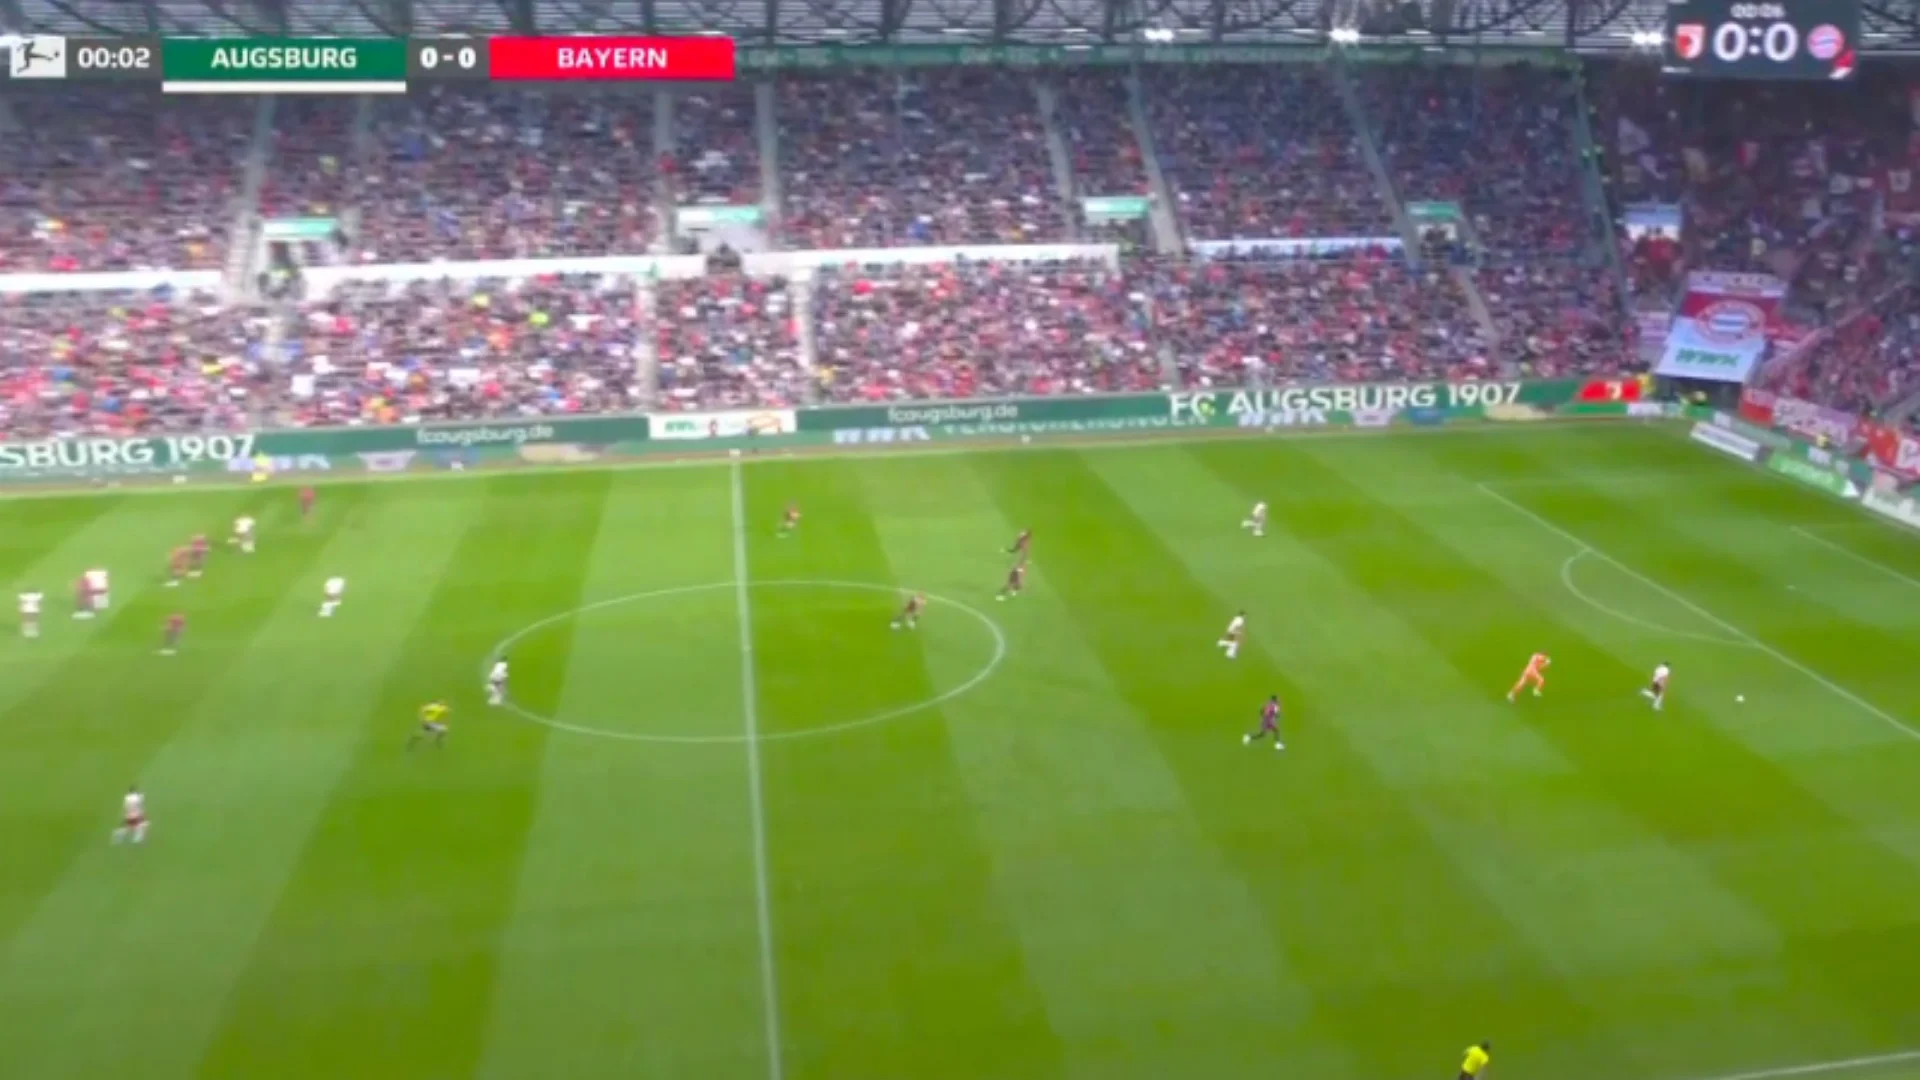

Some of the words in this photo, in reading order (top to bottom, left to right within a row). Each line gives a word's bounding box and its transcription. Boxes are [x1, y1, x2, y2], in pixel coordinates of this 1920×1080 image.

[1713, 22, 1798, 61] 0:0
[887, 403, 1019, 424] fcaugsburg.de
[1169, 391, 1216, 417] FC
[1226, 385, 1437, 415] AUGSBURG
[1447, 382, 1523, 407] 1907
[0, 437, 154, 468] SBURG
[164, 433, 256, 464] 1907
[416, 423, 554, 446] fcaugsburg.de
